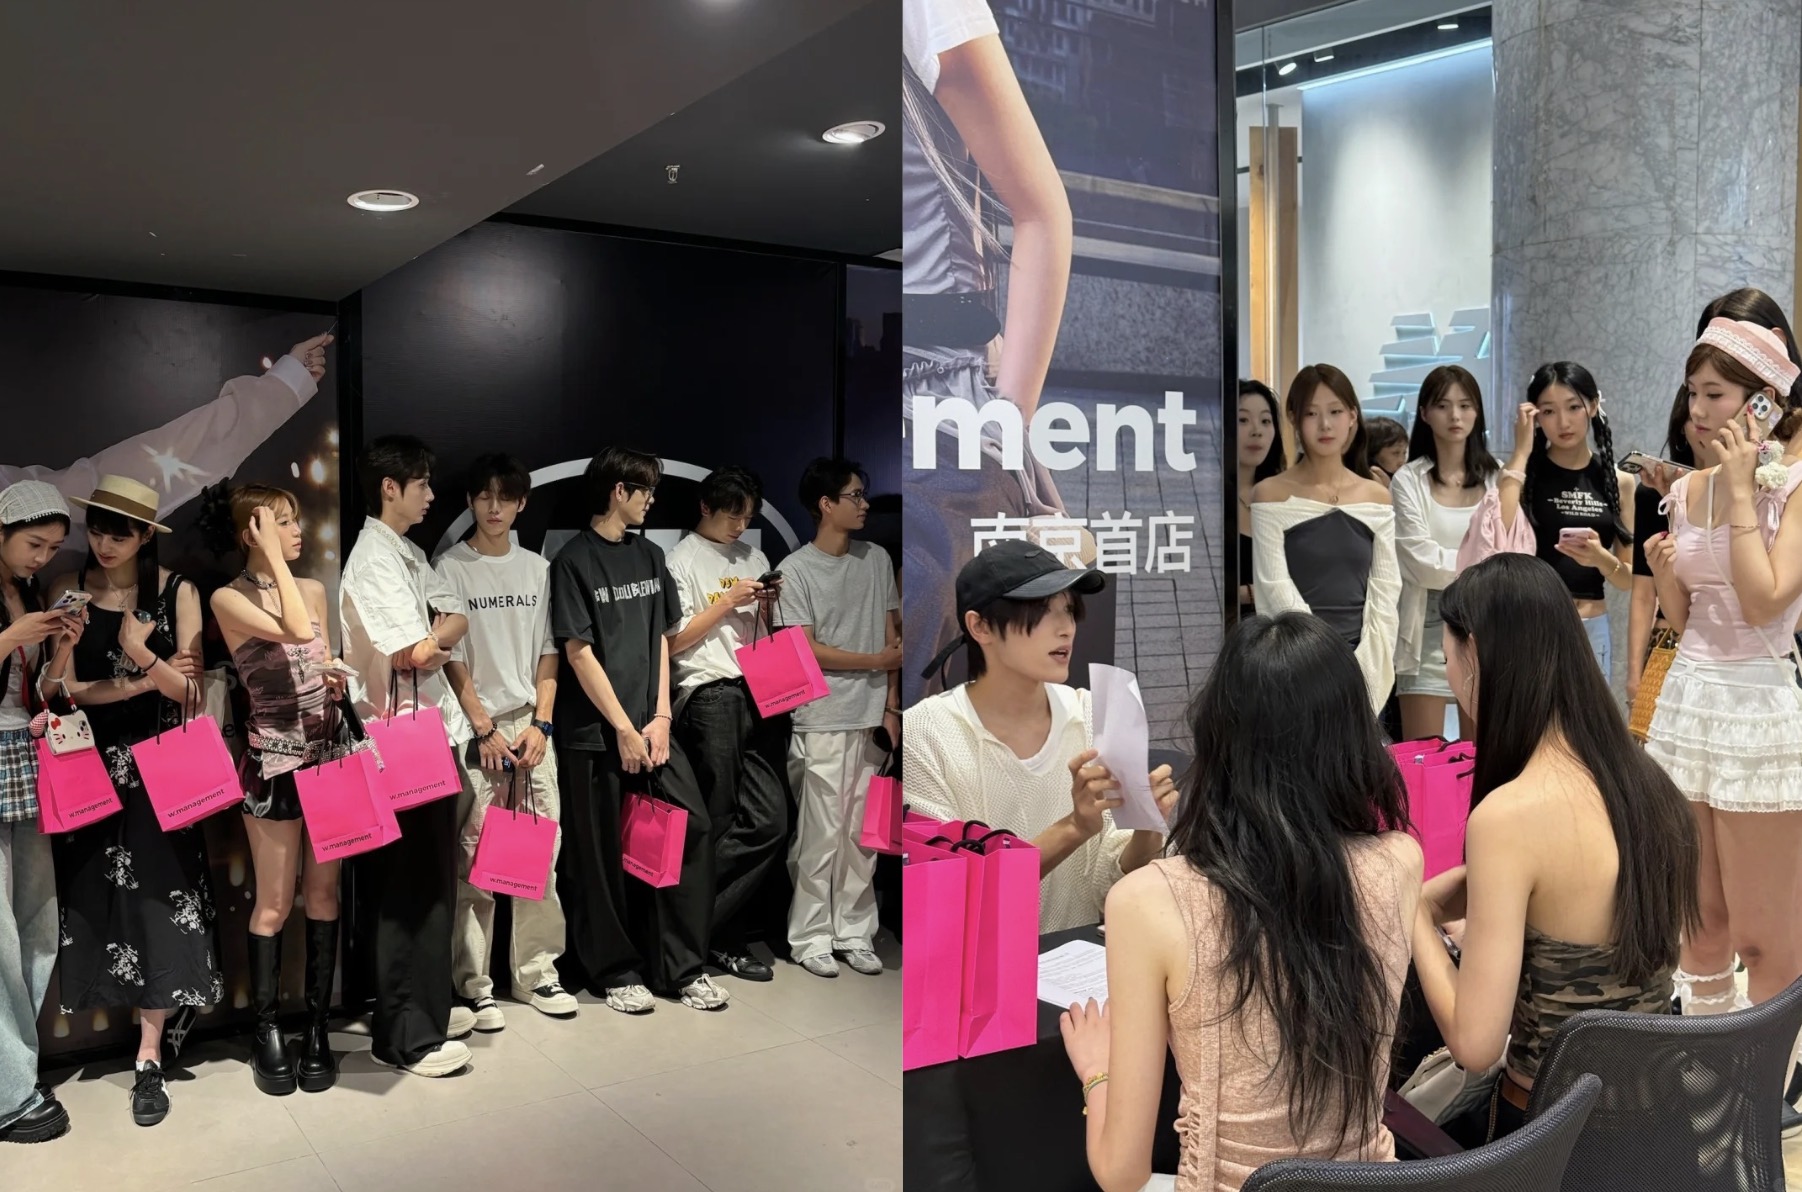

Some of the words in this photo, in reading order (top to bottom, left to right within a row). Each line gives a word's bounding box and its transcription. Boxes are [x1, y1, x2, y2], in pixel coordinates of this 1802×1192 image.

[903, 390, 1197, 472] ment
[1553, 498, 1583, 506] Beverly
[1561, 491, 1594, 500] SMFK
[1571, 505, 1604, 513] Angeles
[468, 594, 538, 611] NUMERALS
[764, 689, 806, 709] w.management
[388, 780, 446, 800] w.management
[68, 797, 113, 818] w.management
[167, 788, 225, 818] w.management
[321, 833, 373, 852] w.management
[489, 877, 538, 892] w.management
